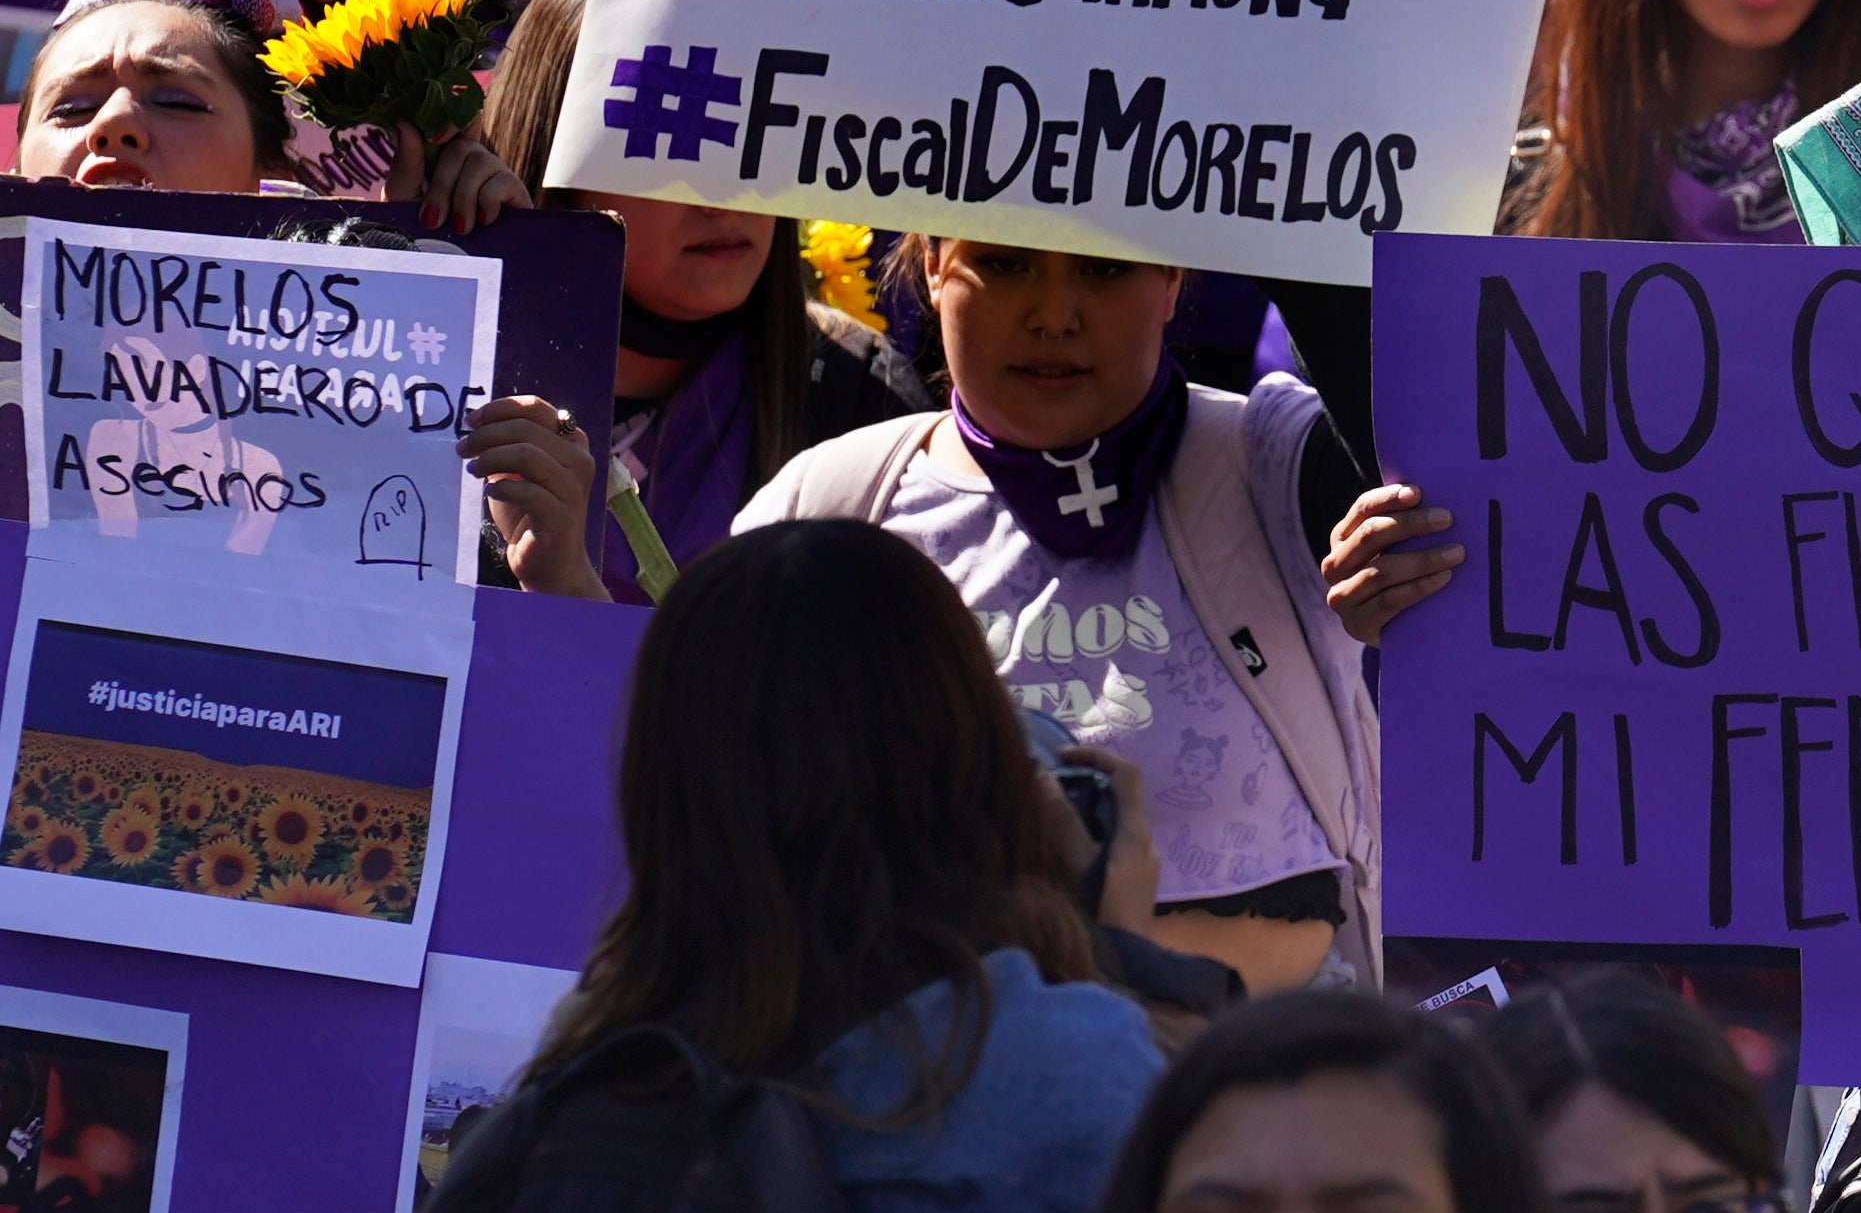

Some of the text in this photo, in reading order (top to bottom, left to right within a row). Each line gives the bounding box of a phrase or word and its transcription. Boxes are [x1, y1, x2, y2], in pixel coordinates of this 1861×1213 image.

[53, 236, 361, 344] MORELOS
[48, 348, 384, 428] LAVADERO
[1475, 260, 1720, 473] NO
[53, 433, 326, 513] Asesinos
[372, 489, 407, 533] RIP
[1487, 491, 1721, 669] LAS
[87, 679, 342, 741] #justiciaparaARI
[1471, 710, 1639, 866] MI
[1431, 981, 1475, 1008] BUSCA
